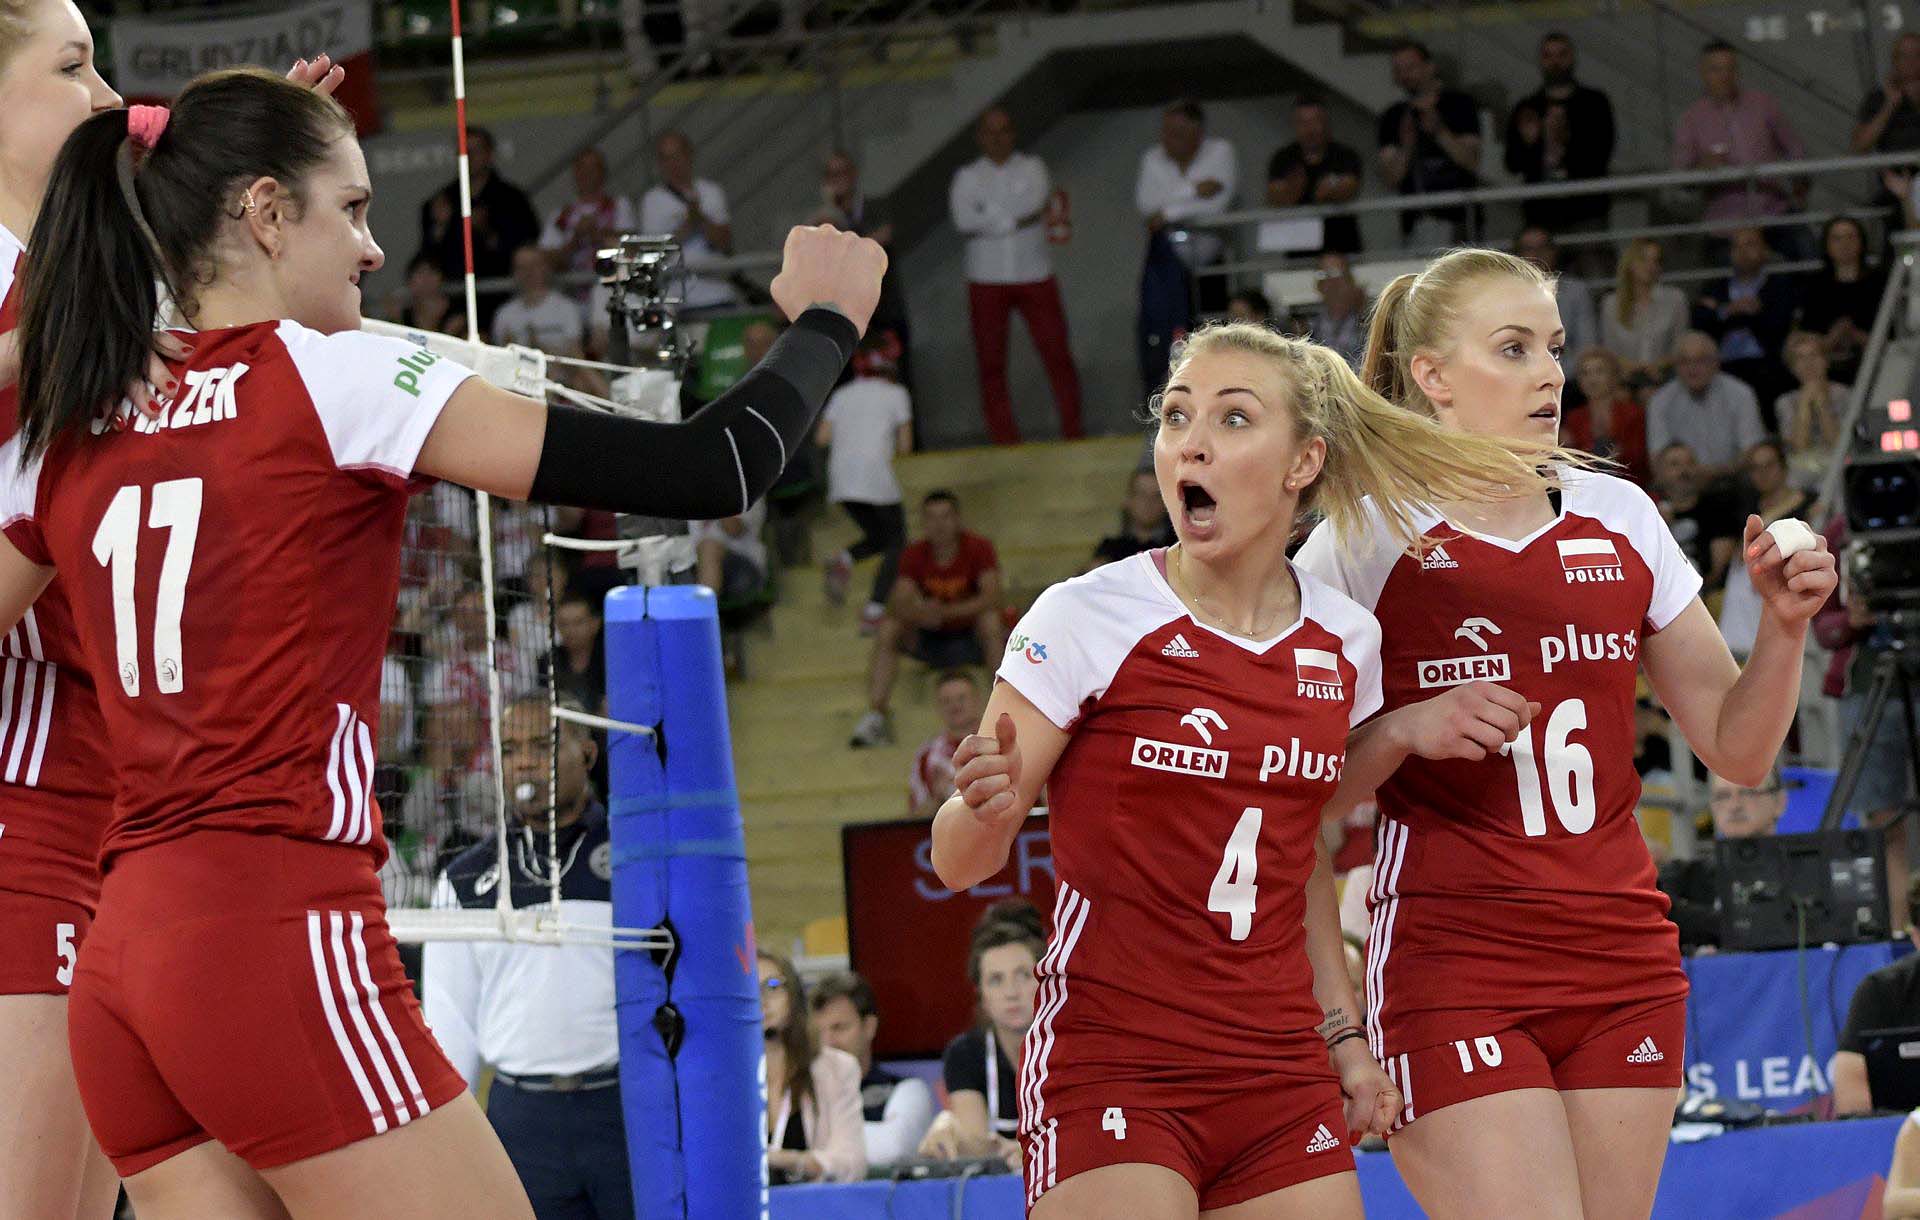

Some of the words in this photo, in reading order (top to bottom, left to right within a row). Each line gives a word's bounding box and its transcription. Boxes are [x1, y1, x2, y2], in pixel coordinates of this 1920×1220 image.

[394, 345, 441, 397] plu
[1423, 558, 1459, 570] adidas
[1565, 568, 1625, 584] POLSKA
[92, 477, 203, 698] 17
[1161, 647, 1200, 658] adidas
[1540, 624, 1621, 673] plus
[1422, 657, 1505, 684] ORLEN
[1297, 682, 1344, 701] POLSKA
[1137, 743, 1223, 774] ORLEN
[1259, 737, 1338, 782] plus
[1499, 698, 1596, 837] 16
[1207, 807, 1263, 941] 4
[56, 923, 77, 986] 5
[1626, 1050, 1664, 1063] adidas
[1735, 1055, 1835, 1100] LEA
[1102, 1107, 1127, 1140] 4
[1306, 1137, 1340, 1153] adidas
